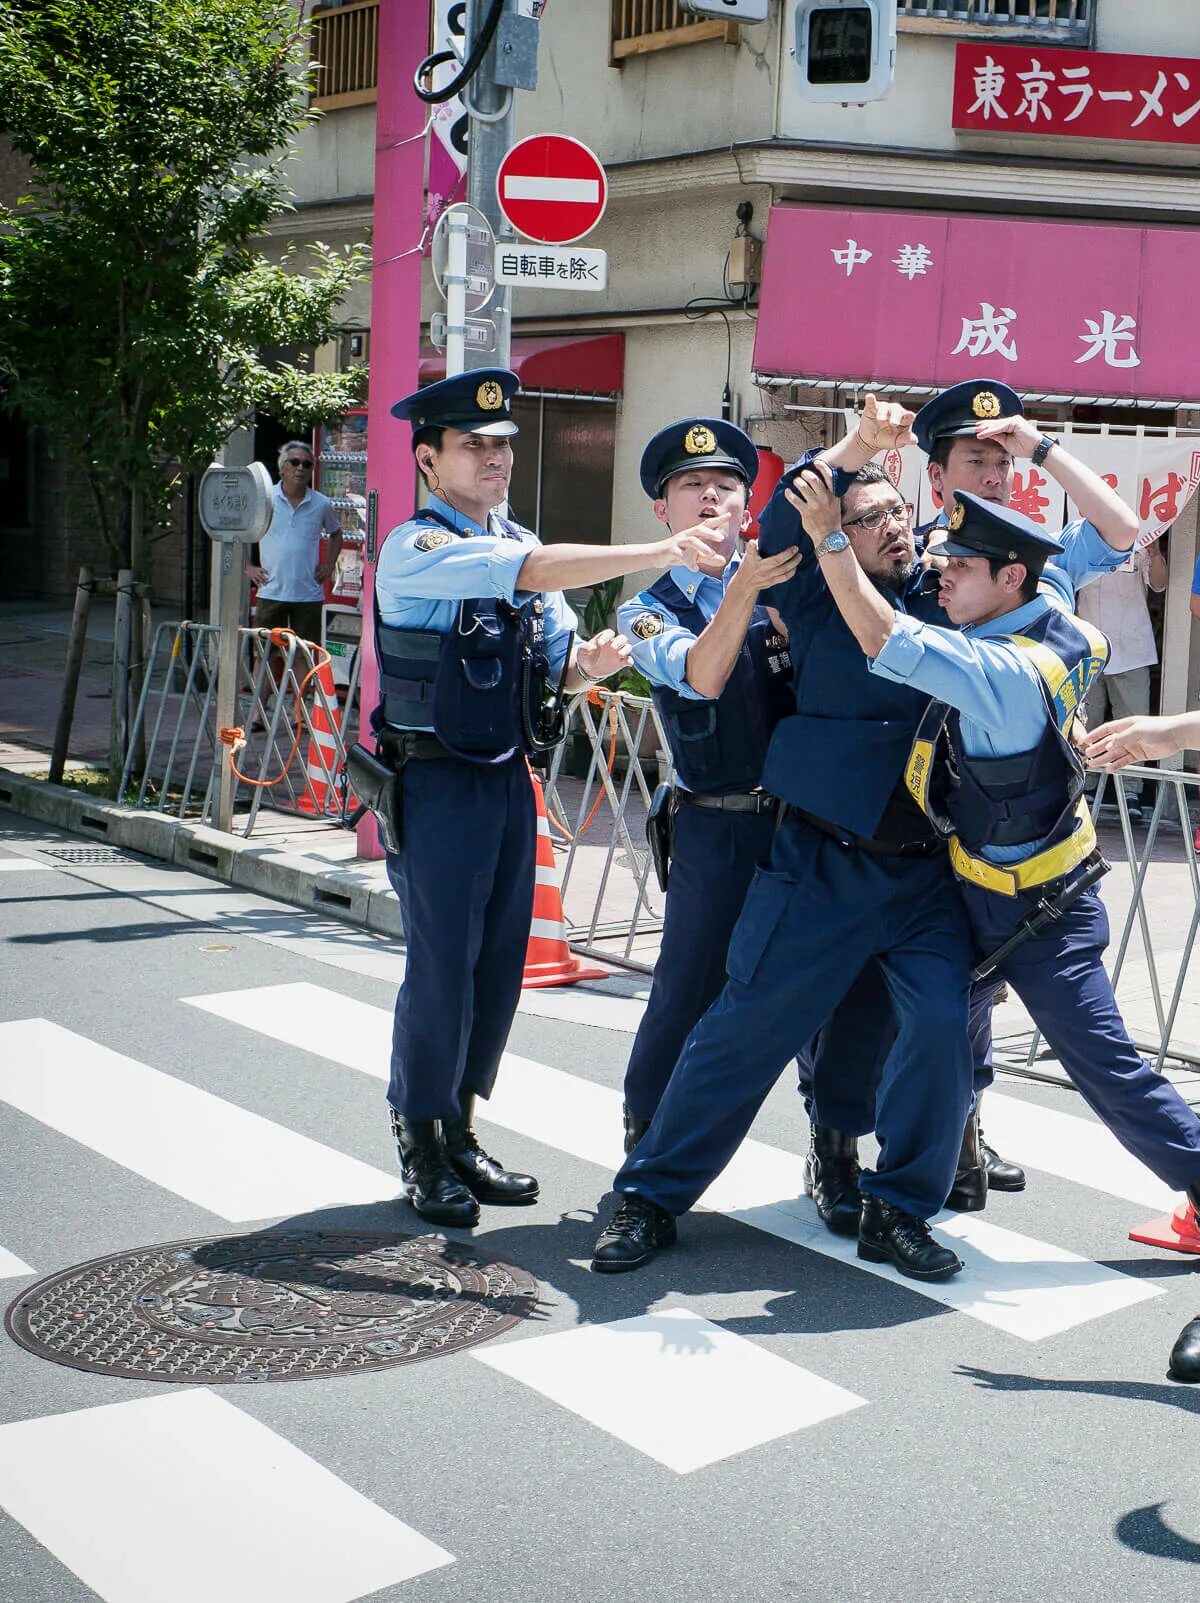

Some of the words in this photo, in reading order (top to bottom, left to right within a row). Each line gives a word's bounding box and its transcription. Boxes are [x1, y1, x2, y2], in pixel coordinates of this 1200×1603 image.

[502, 253, 600, 281] 自転車を除く
[830, 239, 934, 281] 中華
[951, 302, 1141, 368] 成光
